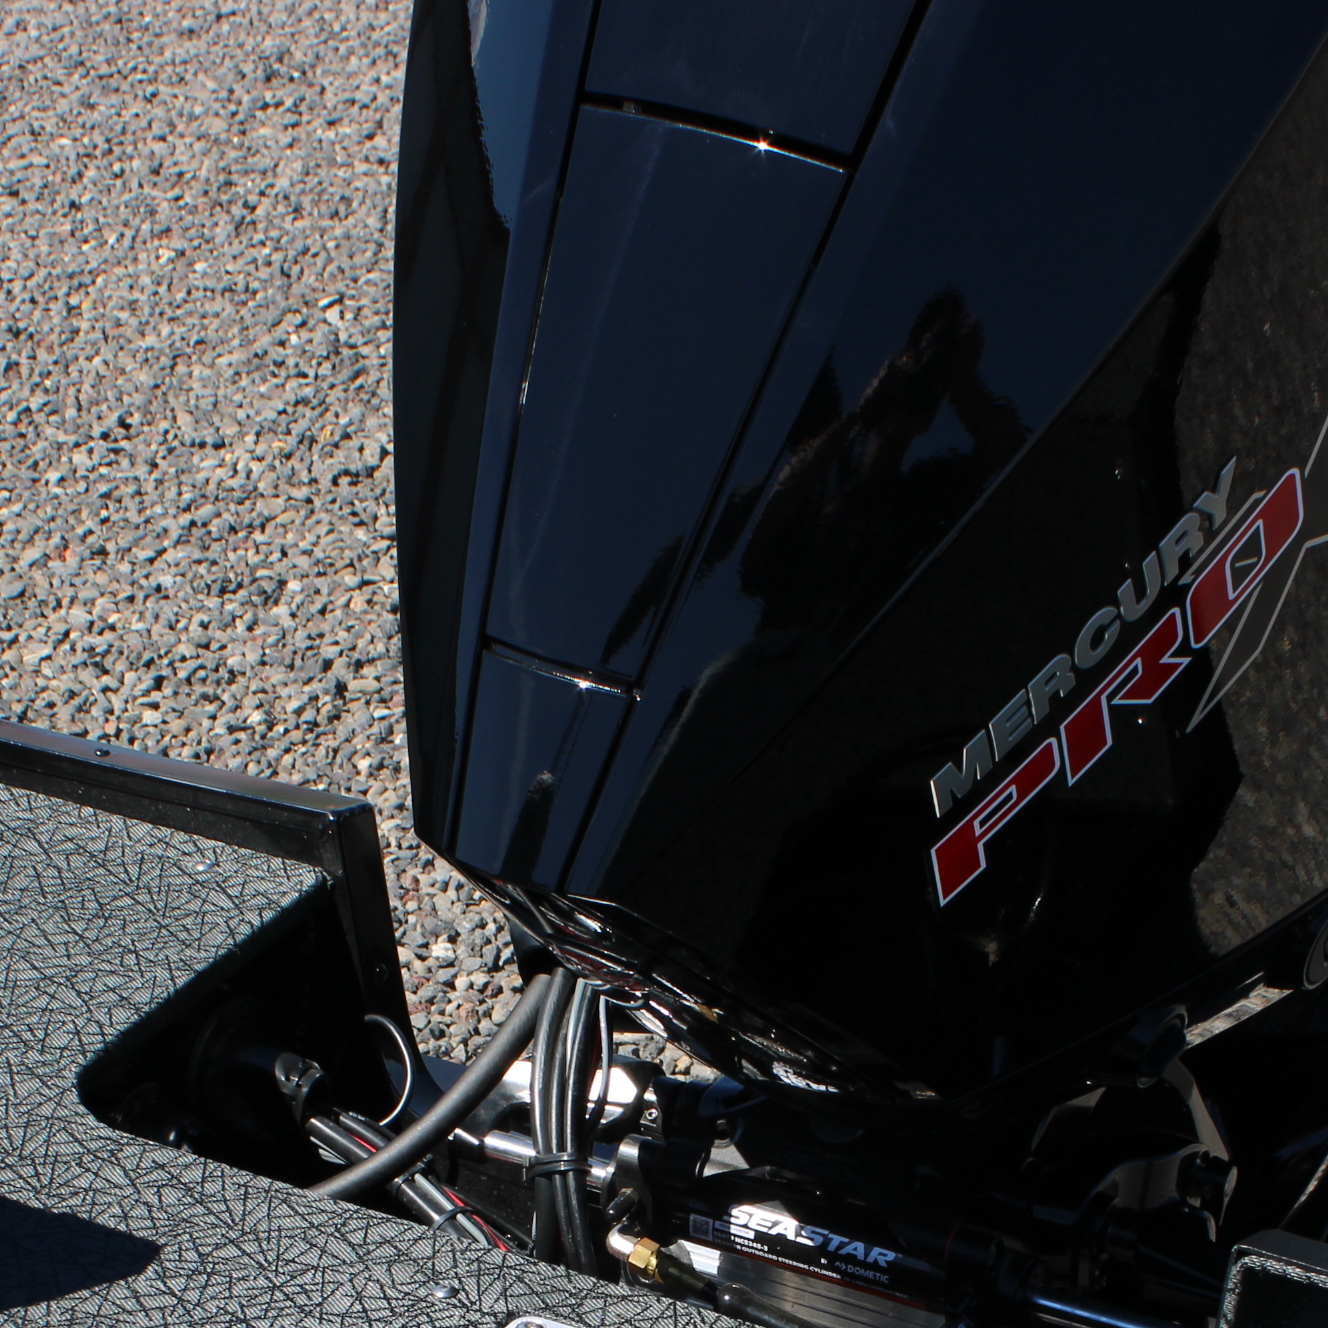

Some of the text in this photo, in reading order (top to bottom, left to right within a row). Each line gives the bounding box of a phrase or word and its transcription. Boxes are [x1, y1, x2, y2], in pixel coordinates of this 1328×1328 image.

[930, 457, 1237, 818] MERCURY
[930, 467, 1303, 908] PRO
[723, 1204, 896, 1268] SEASTAR
[741, 1245, 777, 1261] OUTBOARD
[810, 1266, 842, 1280] CYLINDER
[847, 1265, 889, 1284] DOMETIC
